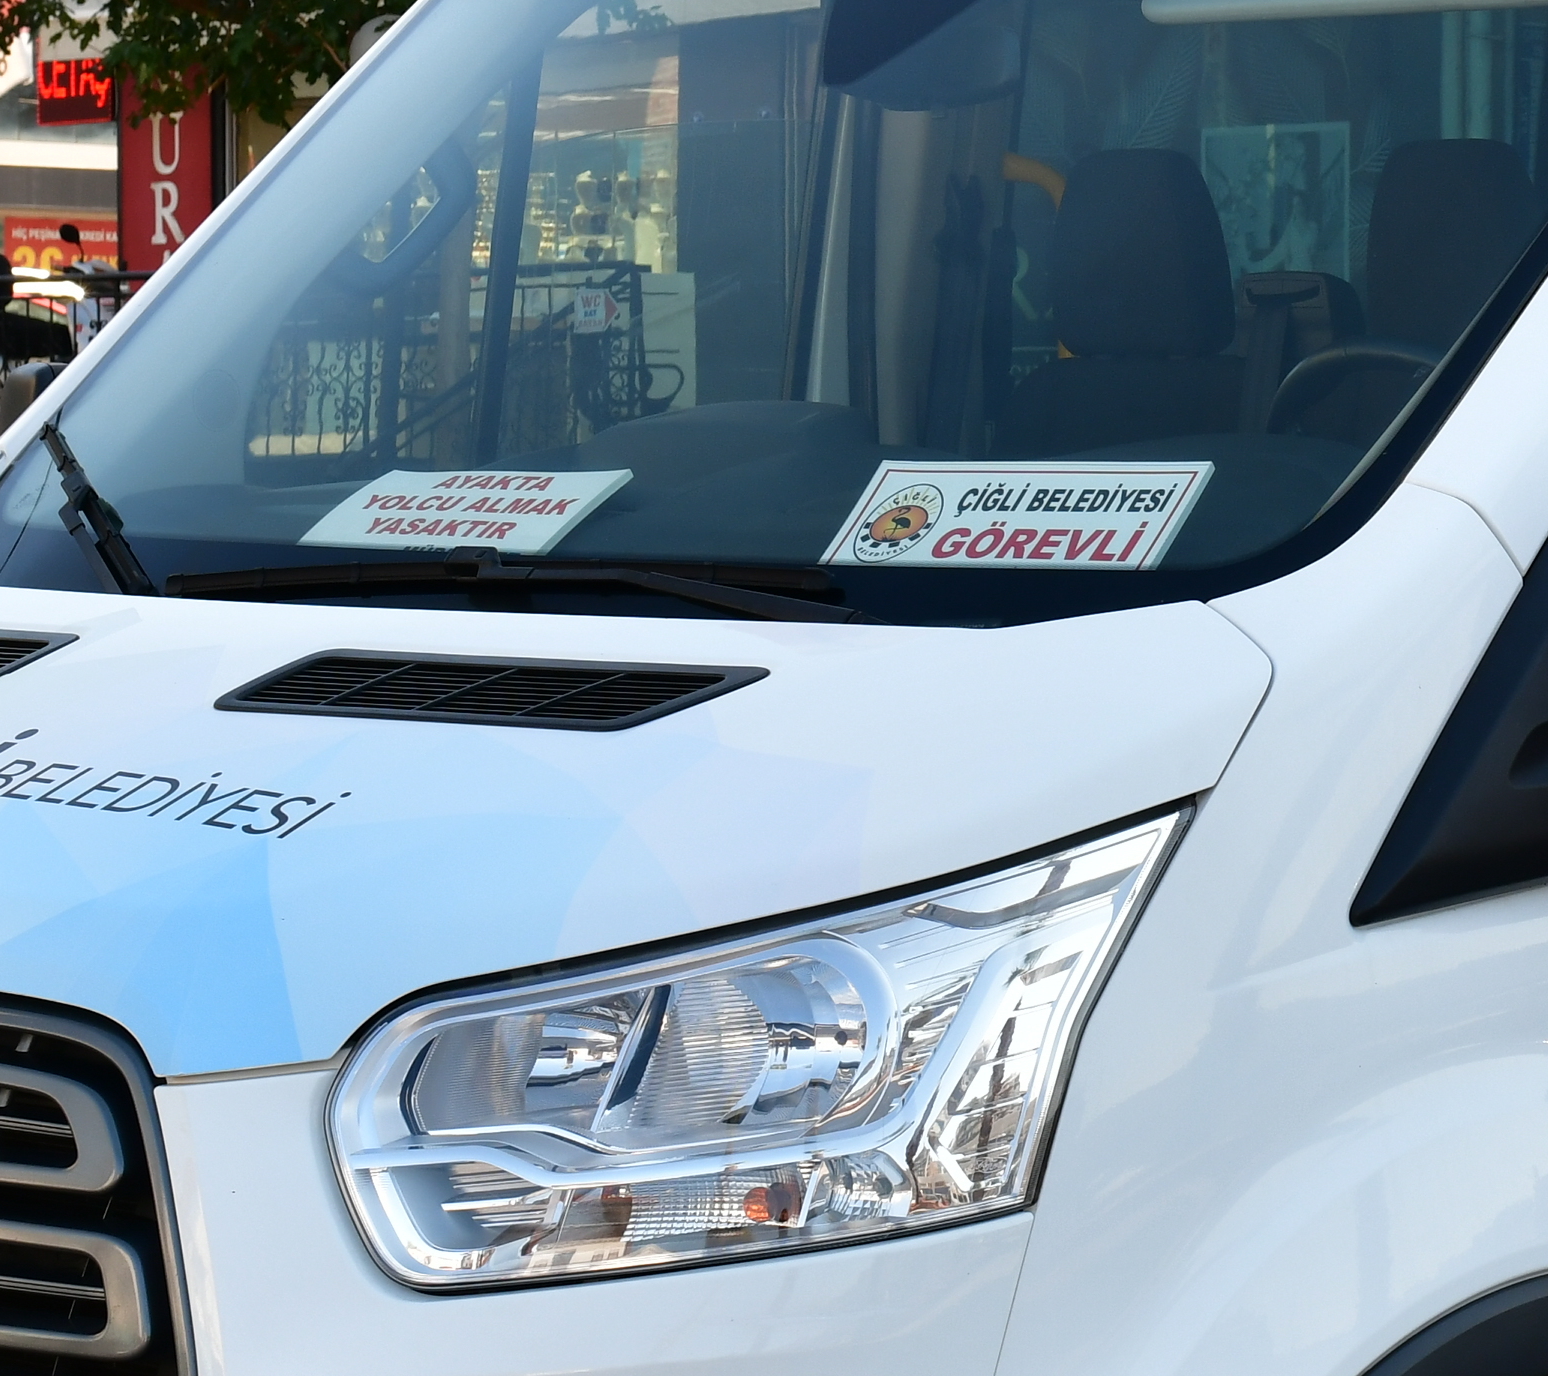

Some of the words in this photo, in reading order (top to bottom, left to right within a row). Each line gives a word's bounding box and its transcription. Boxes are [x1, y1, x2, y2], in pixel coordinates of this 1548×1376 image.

[431, 475, 555, 491] AYAKTA
[362, 494, 460, 512] YOLCU
[460, 496, 580, 515] ALMAK
[954, 482, 1032, 518] ÇİĞLİ
[1026, 483, 1179, 514] BELEDİYESİ
[365, 517, 518, 539] YASAKTIR
[931, 521, 1150, 563] GÖREVLİ
